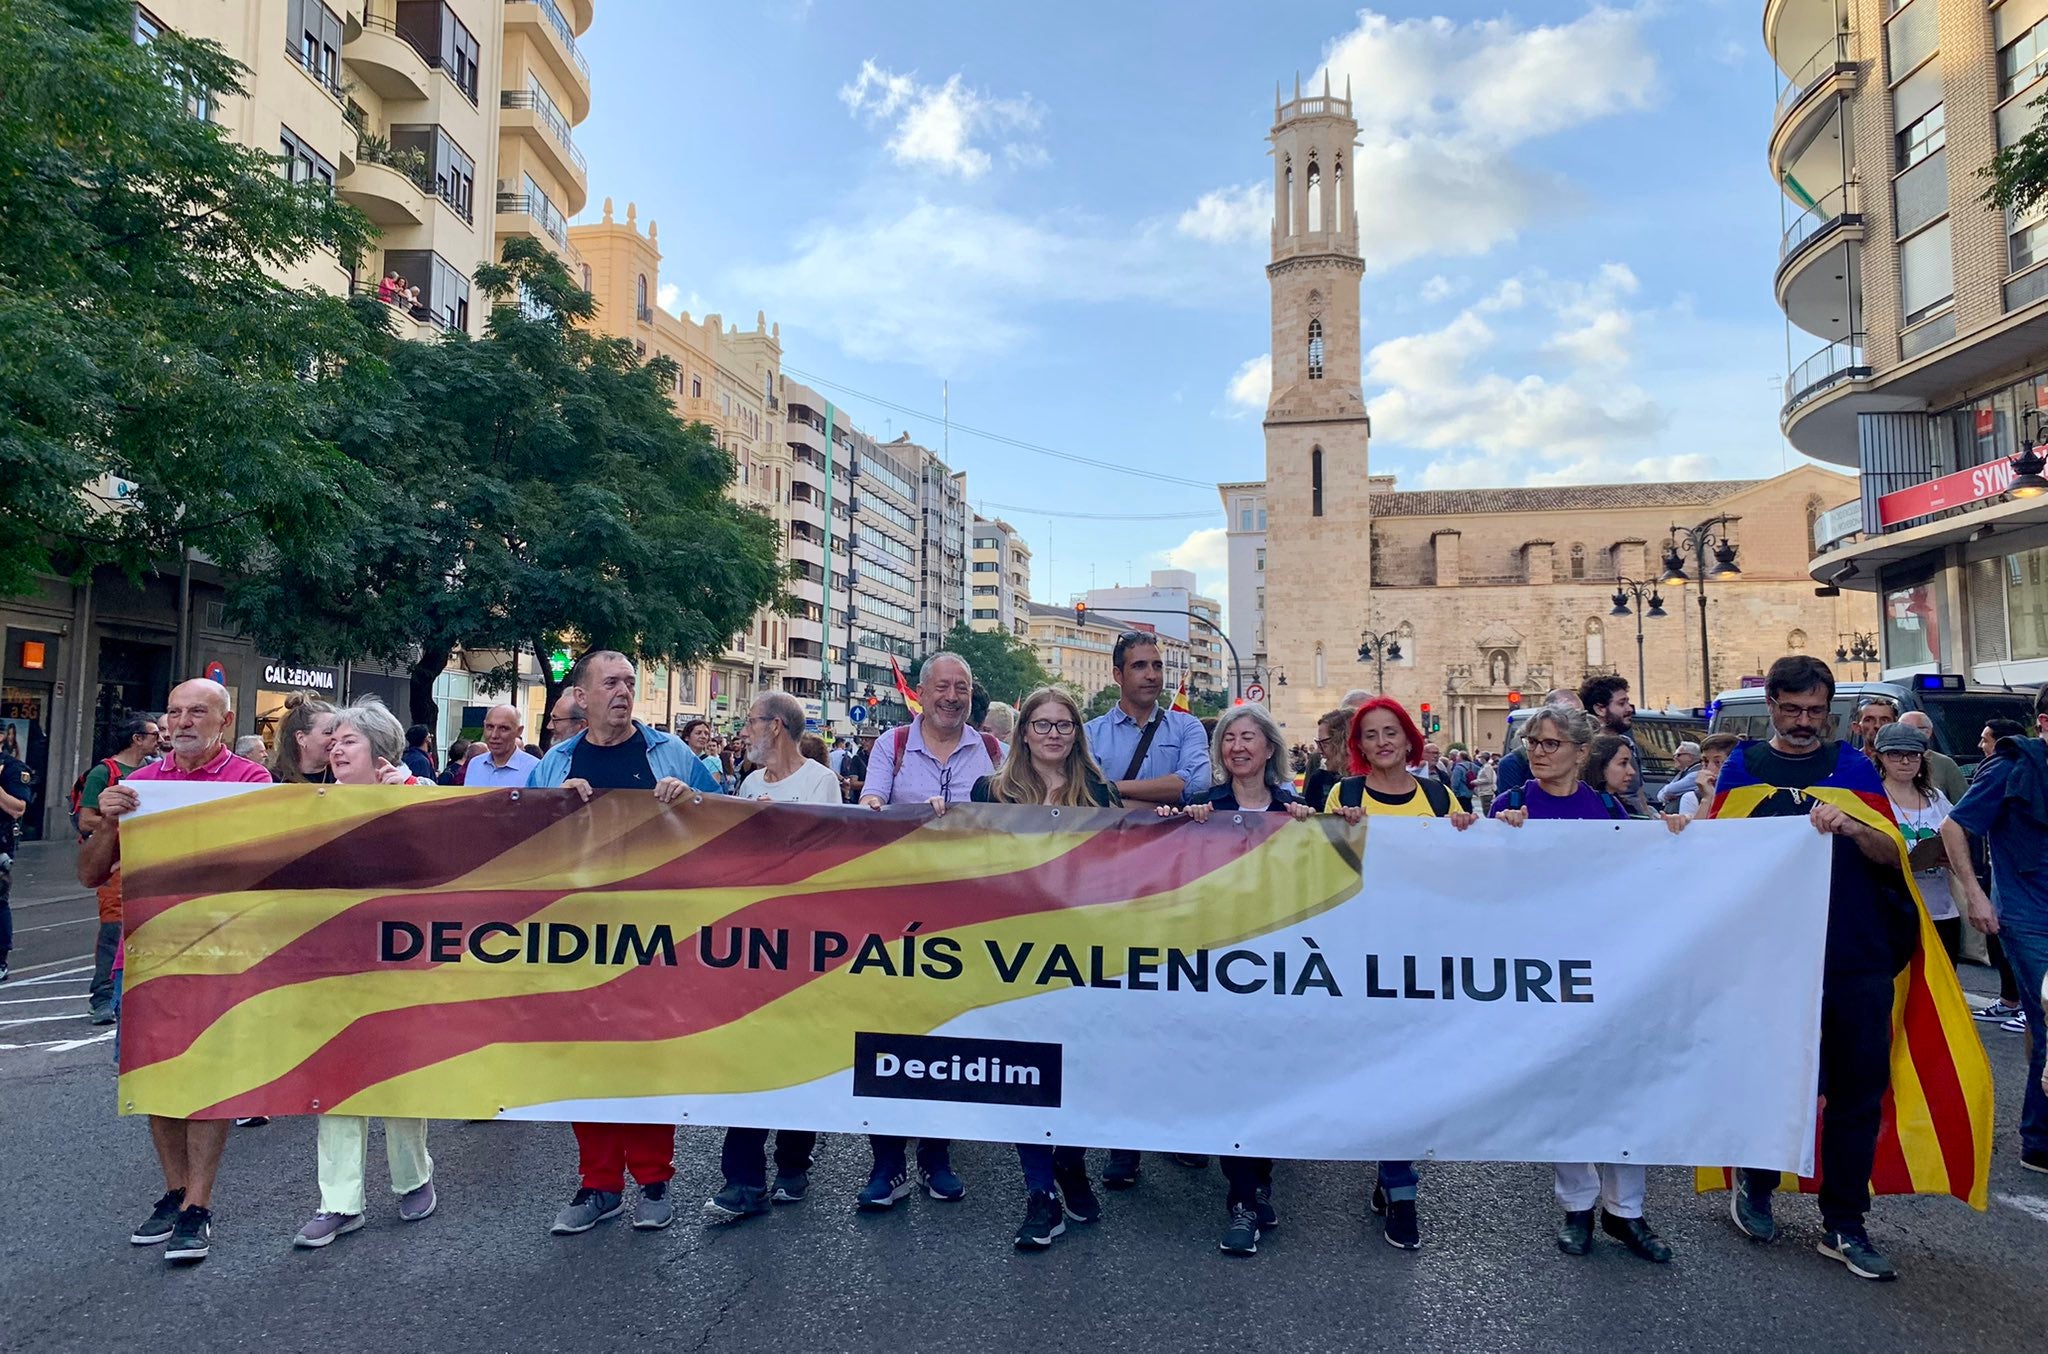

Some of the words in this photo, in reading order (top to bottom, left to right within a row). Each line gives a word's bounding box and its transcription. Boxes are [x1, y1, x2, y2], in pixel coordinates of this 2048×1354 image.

[264, 664, 334, 689] CALZEDONIA
[380, 920, 679, 967] DECIDIM
[700, 925, 789, 971] UN
[812, 921, 964, 980] PAÍS
[984, 936, 1344, 997] VALENCIÀ
[1365, 954, 1595, 1003] LLIURE
[875, 1052, 1041, 1085] Decidim
